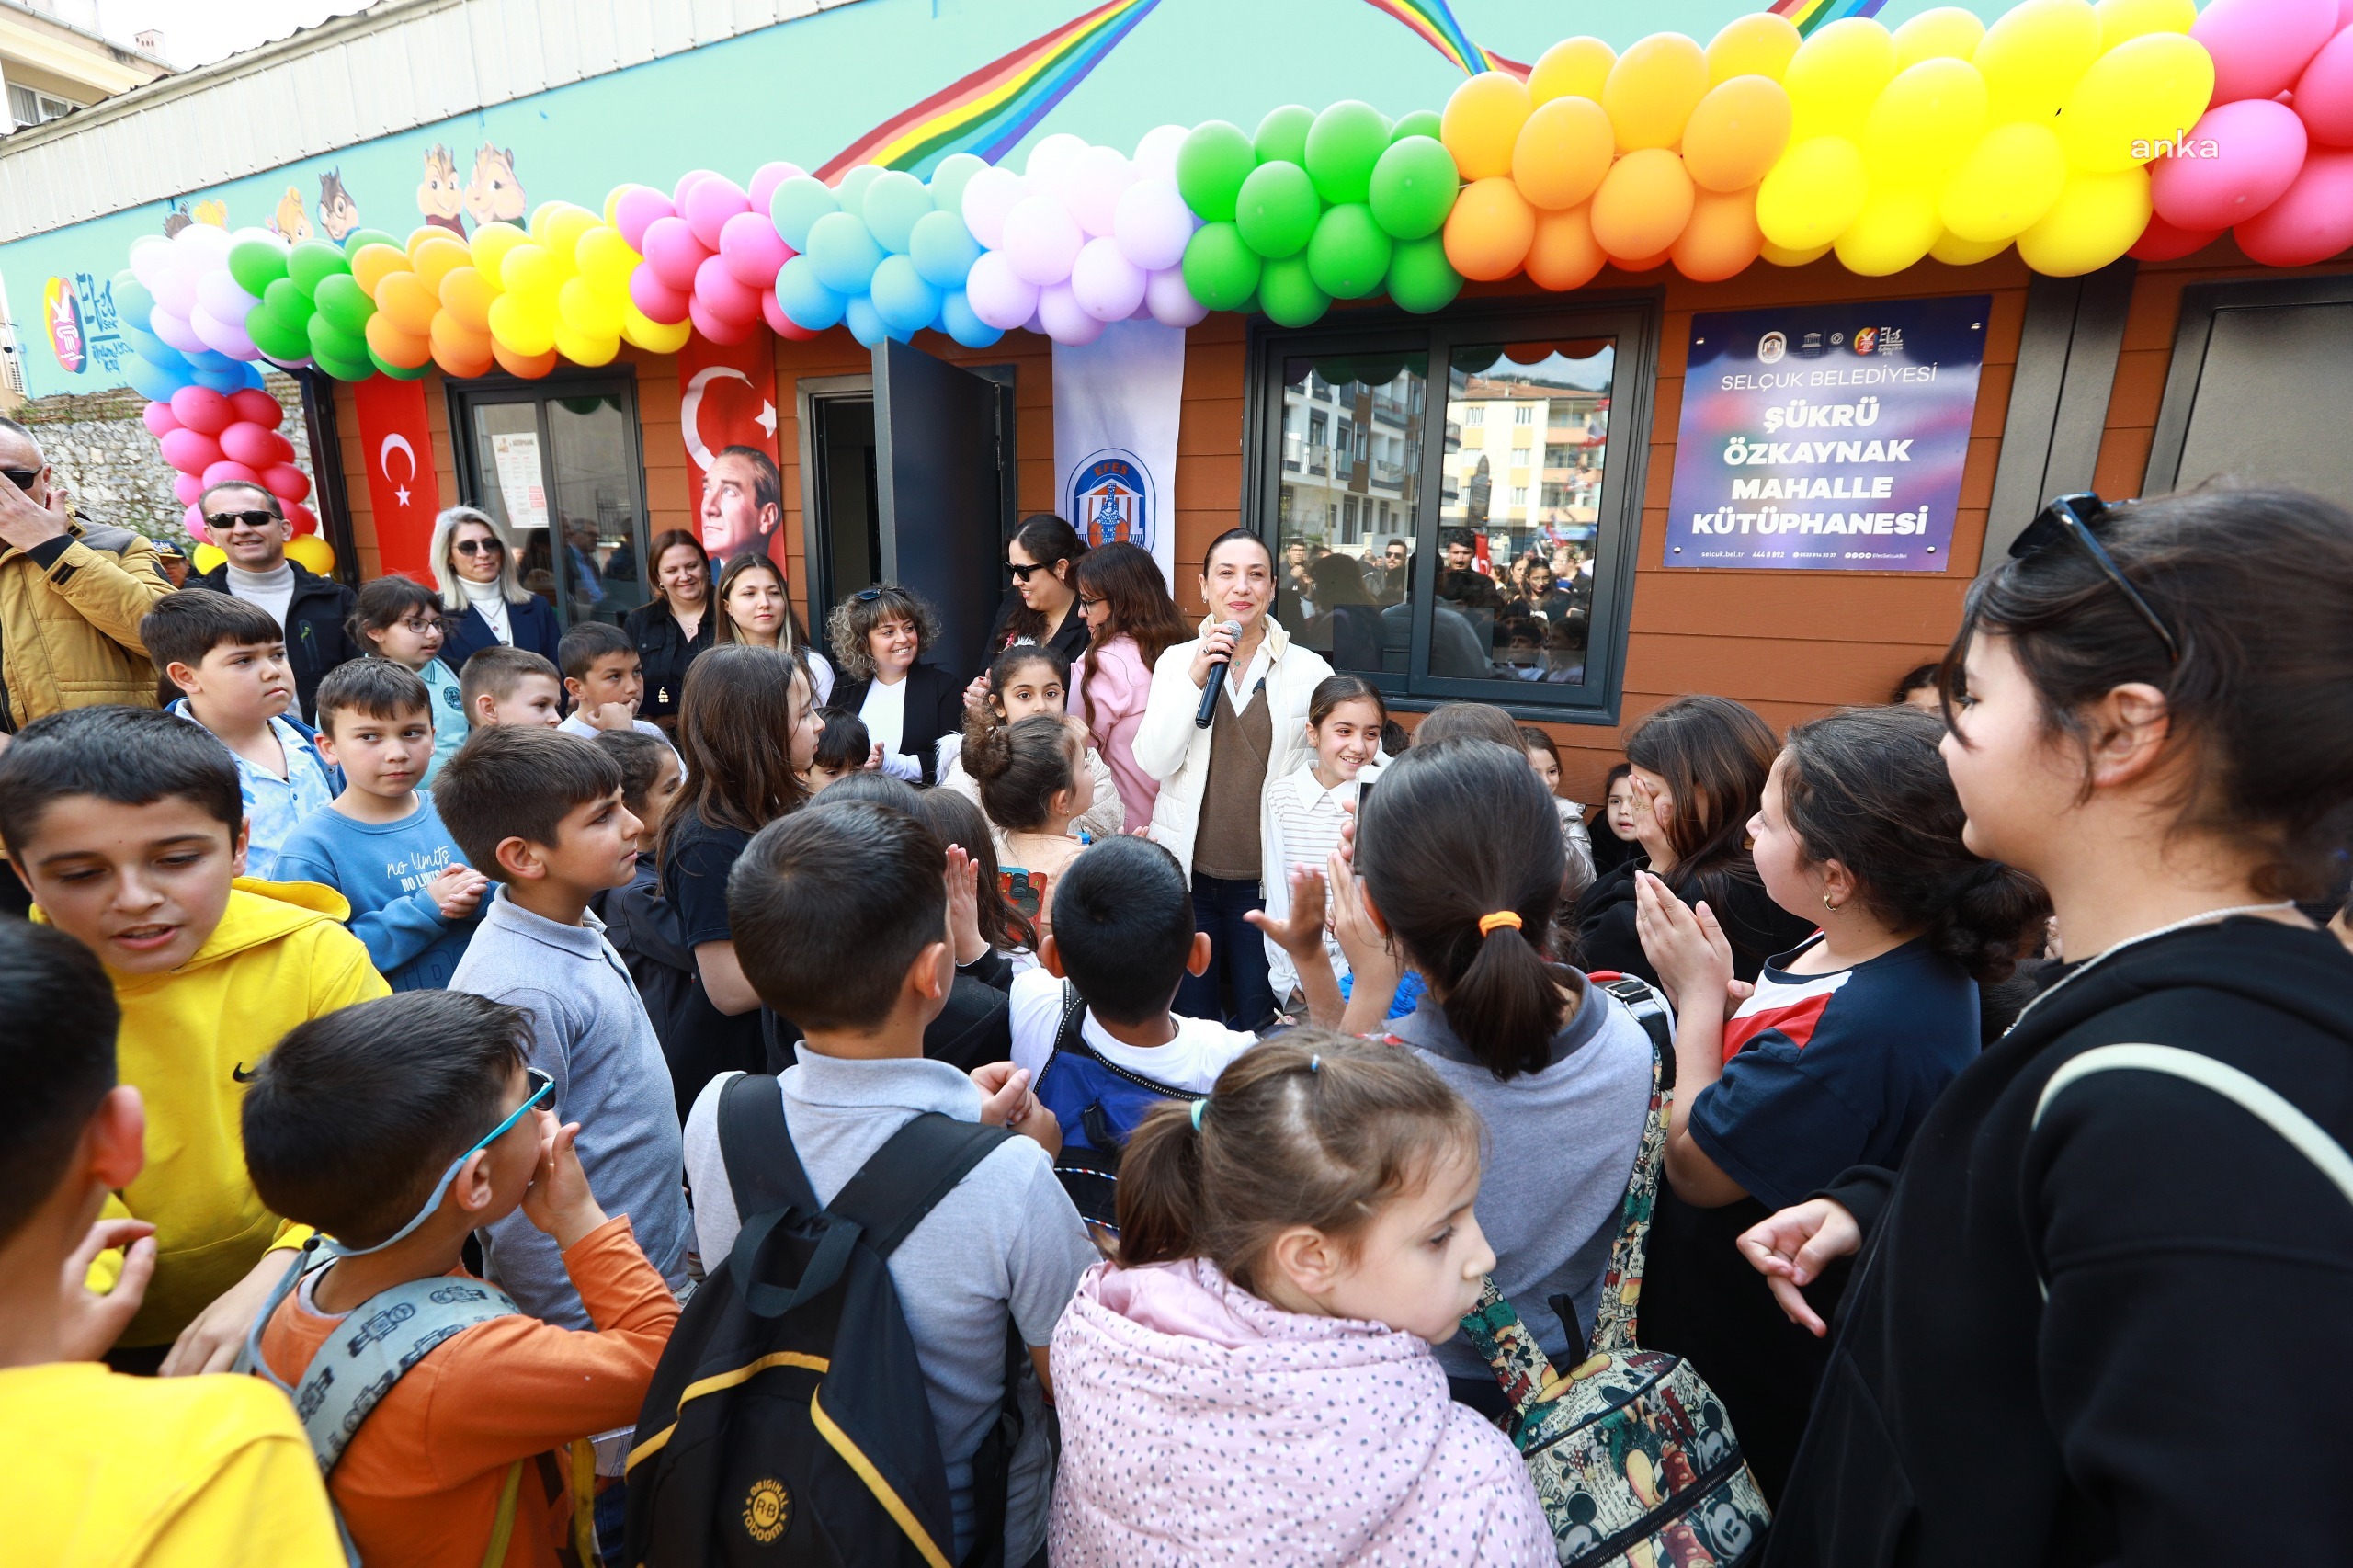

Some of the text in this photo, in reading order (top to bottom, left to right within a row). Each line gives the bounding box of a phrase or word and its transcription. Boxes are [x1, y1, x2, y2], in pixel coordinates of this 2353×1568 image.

[1721, 361, 1938, 392] SELÇUK BELEDİYESİ
[1763, 395, 1880, 434] ŞÜKRÜ
[1723, 437, 1915, 466] ÖZKAYNAK
[1094, 462, 1129, 477] EFES
[1732, 476, 1894, 500] MAHALLE
[1691, 505, 1929, 536] KÜTÜPHANESİ
[1701, 551, 1745, 559] selcuk.bel.tr
[387, 845, 450, 880] no limits
[400, 876, 416, 892] NO
[749, 1478, 790, 1510] ORIGINAL
[742, 1508, 785, 1543] raboom
